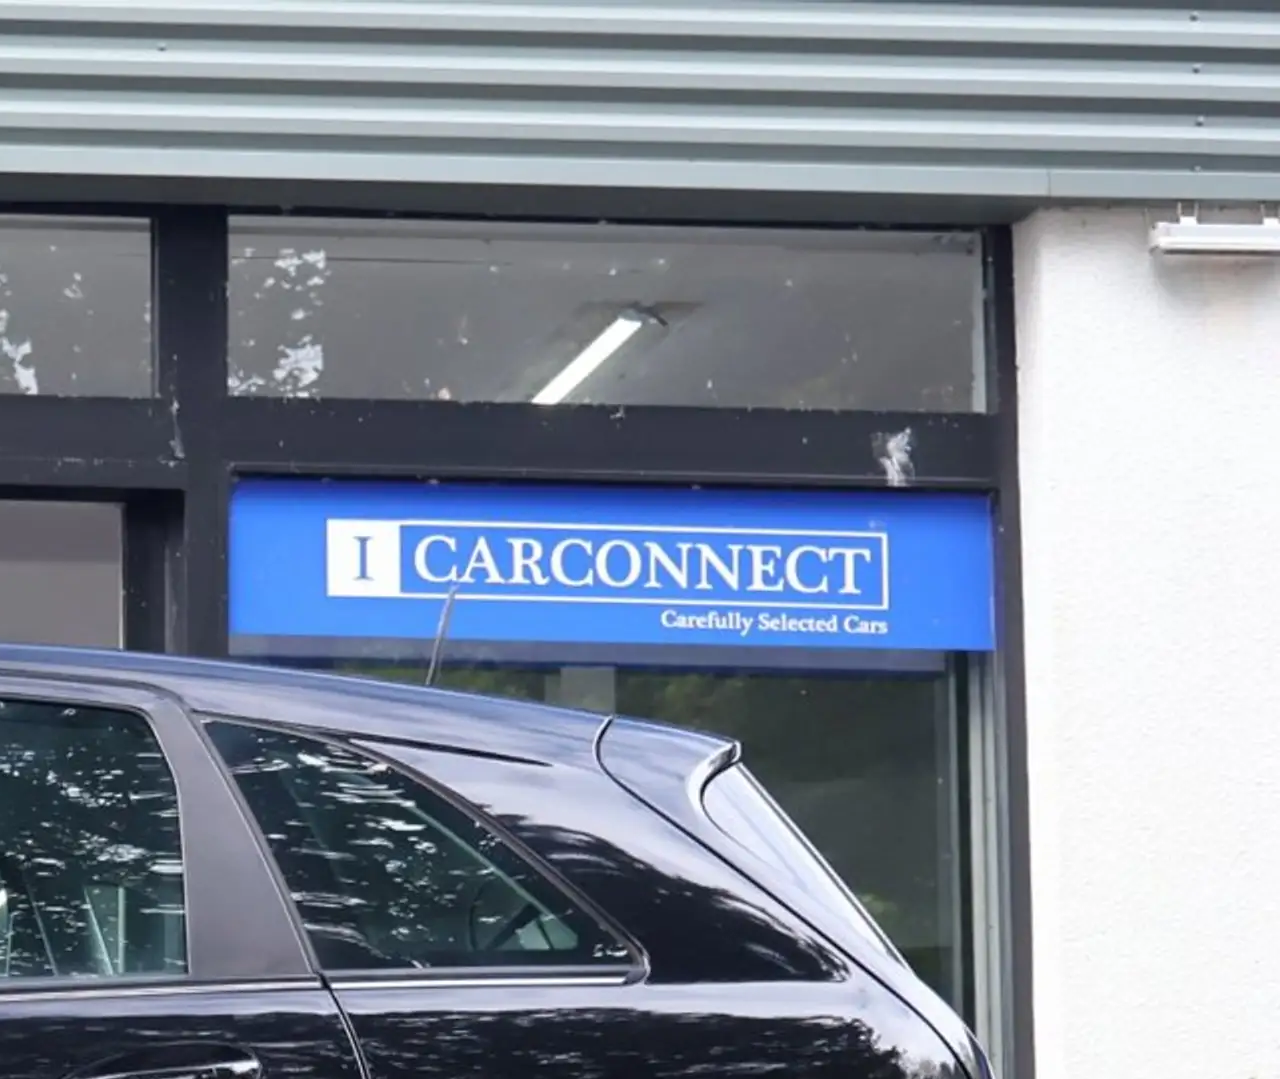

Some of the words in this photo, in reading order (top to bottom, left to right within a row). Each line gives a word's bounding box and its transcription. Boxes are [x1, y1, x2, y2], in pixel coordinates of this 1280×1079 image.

[413, 534, 871, 595] CARCONNECT
[661, 609, 753, 637] Carefully
[758, 612, 837, 633] Selected
[843, 615, 888, 634] Cars
